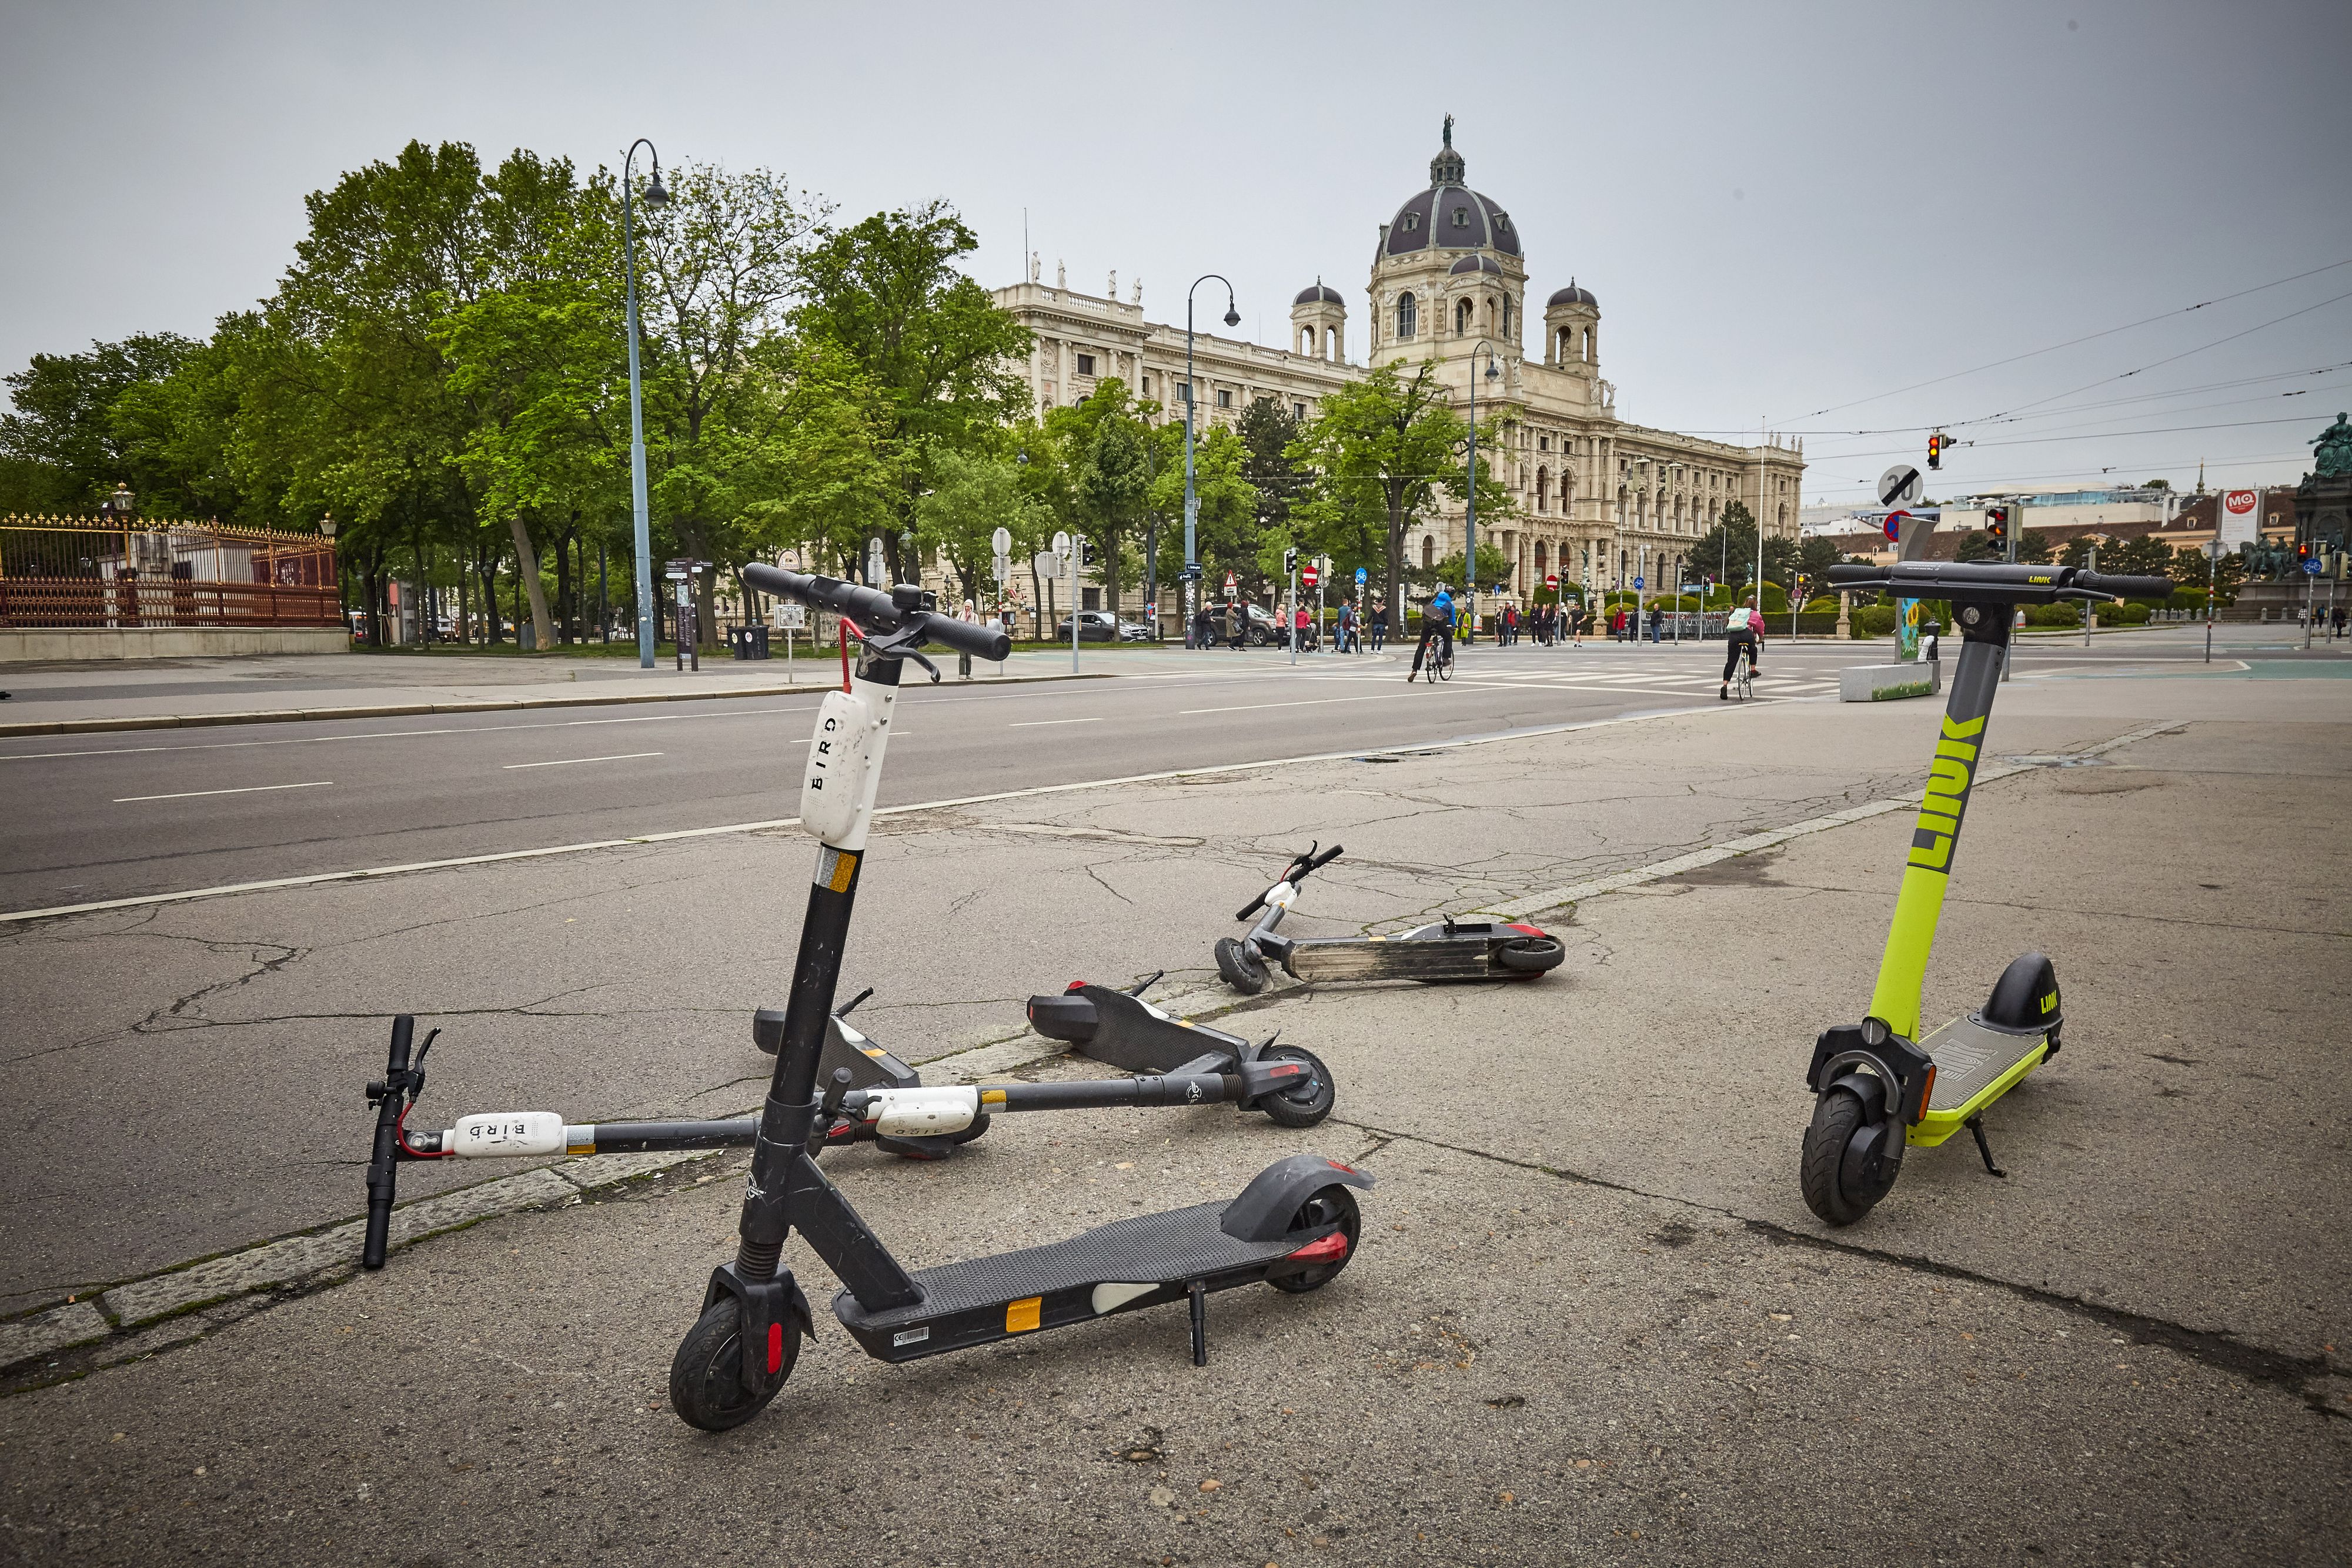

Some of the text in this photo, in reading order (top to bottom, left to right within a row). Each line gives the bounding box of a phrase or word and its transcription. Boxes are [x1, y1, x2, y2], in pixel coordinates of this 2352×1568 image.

[1887, 474, 1914, 501] 30
[2229, 494, 2254, 507] MQ
[811, 718, 836, 790] BIRD
[1907, 712, 1986, 868] LINK
[2040, 989, 2057, 1014] LINK
[470, 1124, 526, 1136] BIRD
